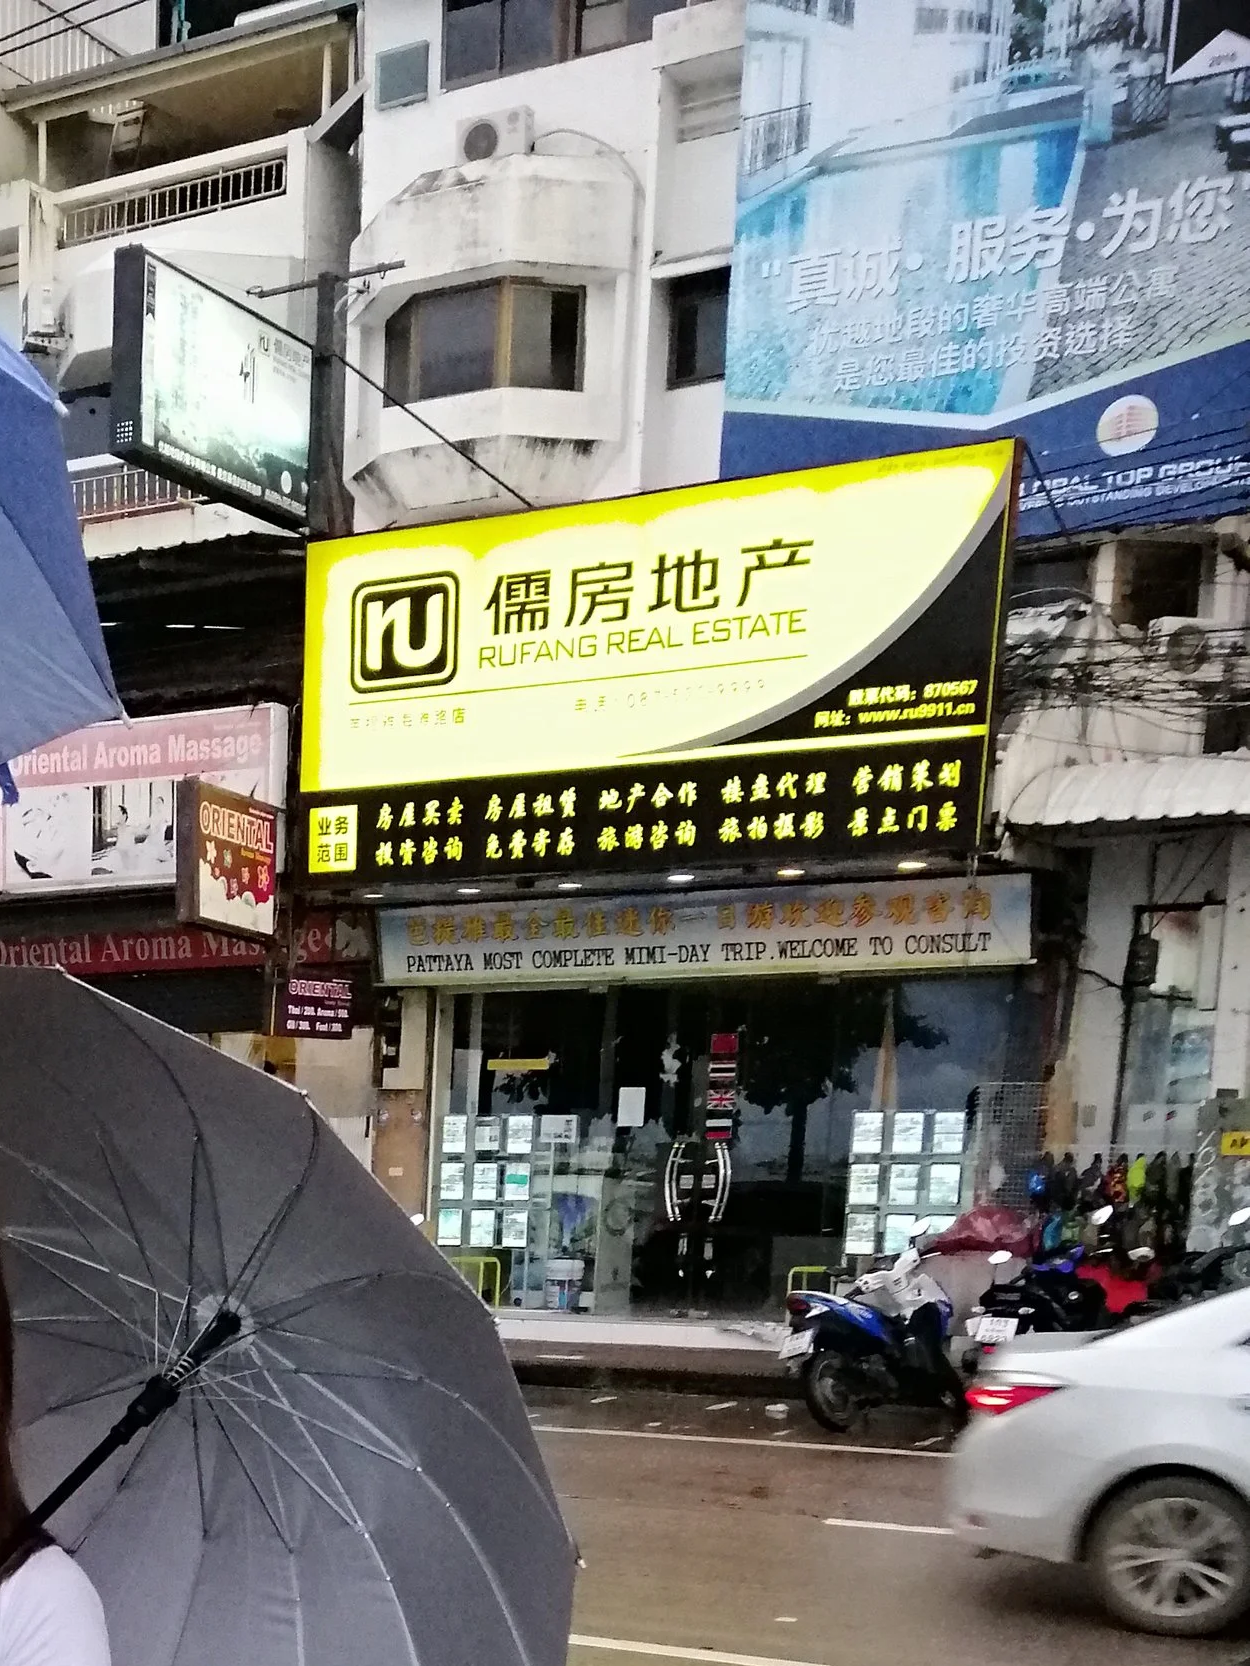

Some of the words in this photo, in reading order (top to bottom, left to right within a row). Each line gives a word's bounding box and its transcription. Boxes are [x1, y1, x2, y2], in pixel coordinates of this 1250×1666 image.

[1102, 466, 1154, 489] TOP
[484, 538, 814, 636] 儒房地产
[478, 634, 597, 669] RUFANG
[607, 622, 683, 654] REAL
[693, 609, 808, 645] ESTATE
[923, 679, 978, 699] 870567
[858, 702, 976, 724] www.ru9911.cn
[9, 744, 88, 776] Oriental
[94, 740, 162, 770] Aroma
[168, 731, 263, 765] Massage
[376, 796, 465, 831] 房屋买卖
[485, 786, 577, 823] 房屋租赁
[598, 781, 698, 814] 地产合作
[720, 771, 827, 805] 楼盘代理
[851, 759, 962, 797] 营销策划
[199, 801, 274, 855] ORIENTAL
[317, 815, 349, 836] 业务
[375, 836, 463, 867] 投资咨询
[485, 826, 575, 860] 免费寄存
[597, 820, 697, 852] 旅游咨询
[718, 810, 824, 843] 旅拍摄影
[847, 801, 957, 837] 景点门票
[317, 842, 349, 863] 范围
[101, 931, 192, 963] Aroma
[202, 927, 319, 964] Masge
[406, 953, 474, 973] PATTAYA
[483, 951, 523, 970] MOST
[532, 947, 615, 969] COMPLETE
[870, 936, 893, 956] TO
[905, 932, 993, 955] CONSULT
[288, 979, 352, 999] ORIENTAL
